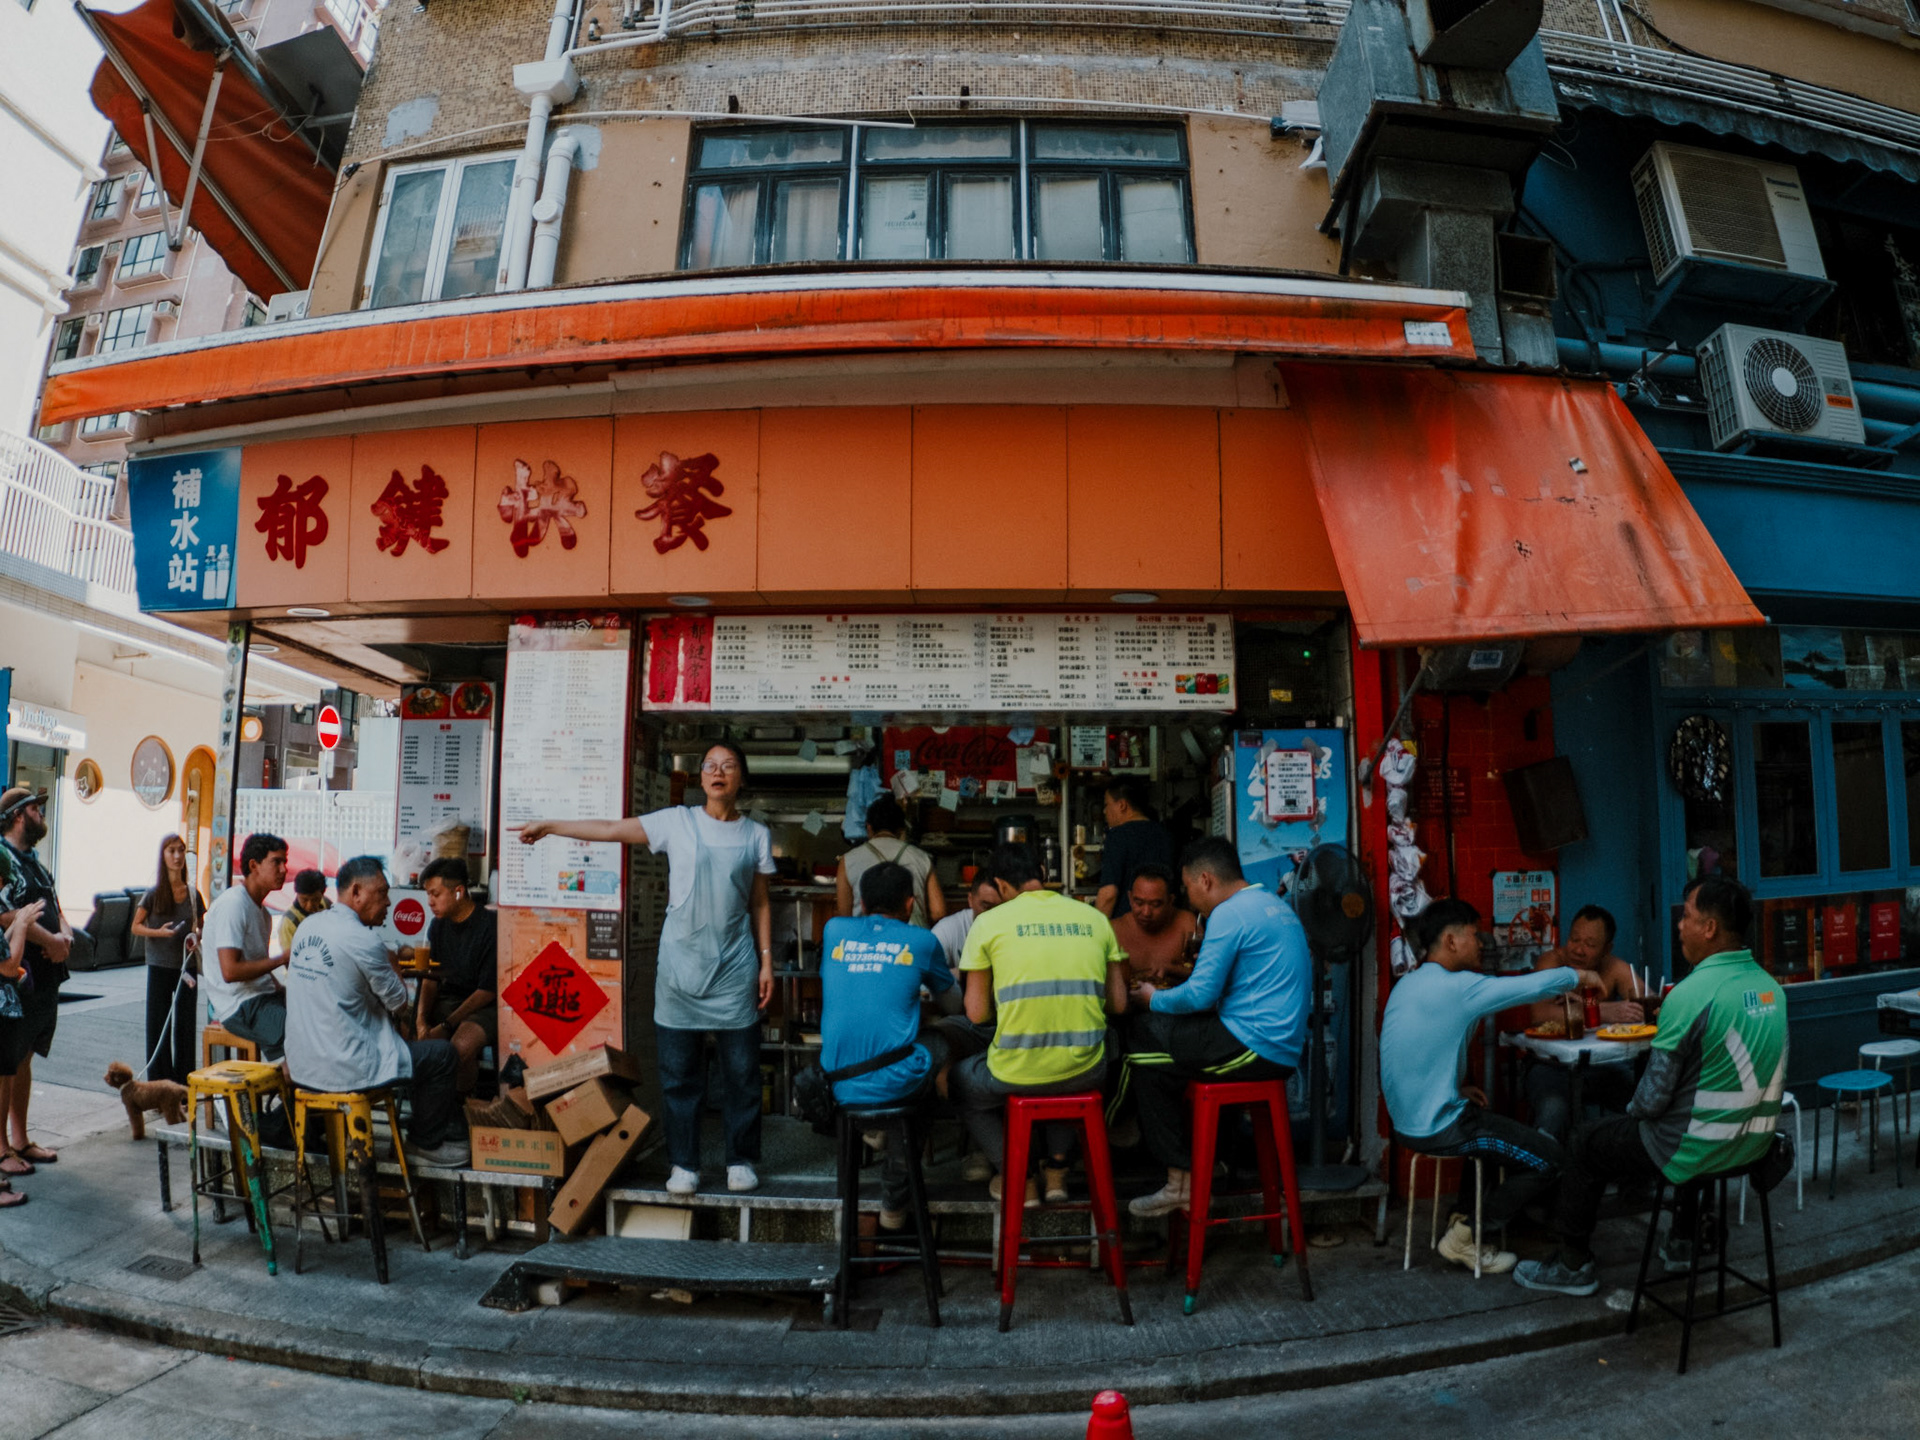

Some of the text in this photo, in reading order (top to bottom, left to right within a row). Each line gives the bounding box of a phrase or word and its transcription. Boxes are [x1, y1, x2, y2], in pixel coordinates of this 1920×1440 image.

[167, 467, 203, 593] 補水站
[320, 943, 334, 967] SHOP
